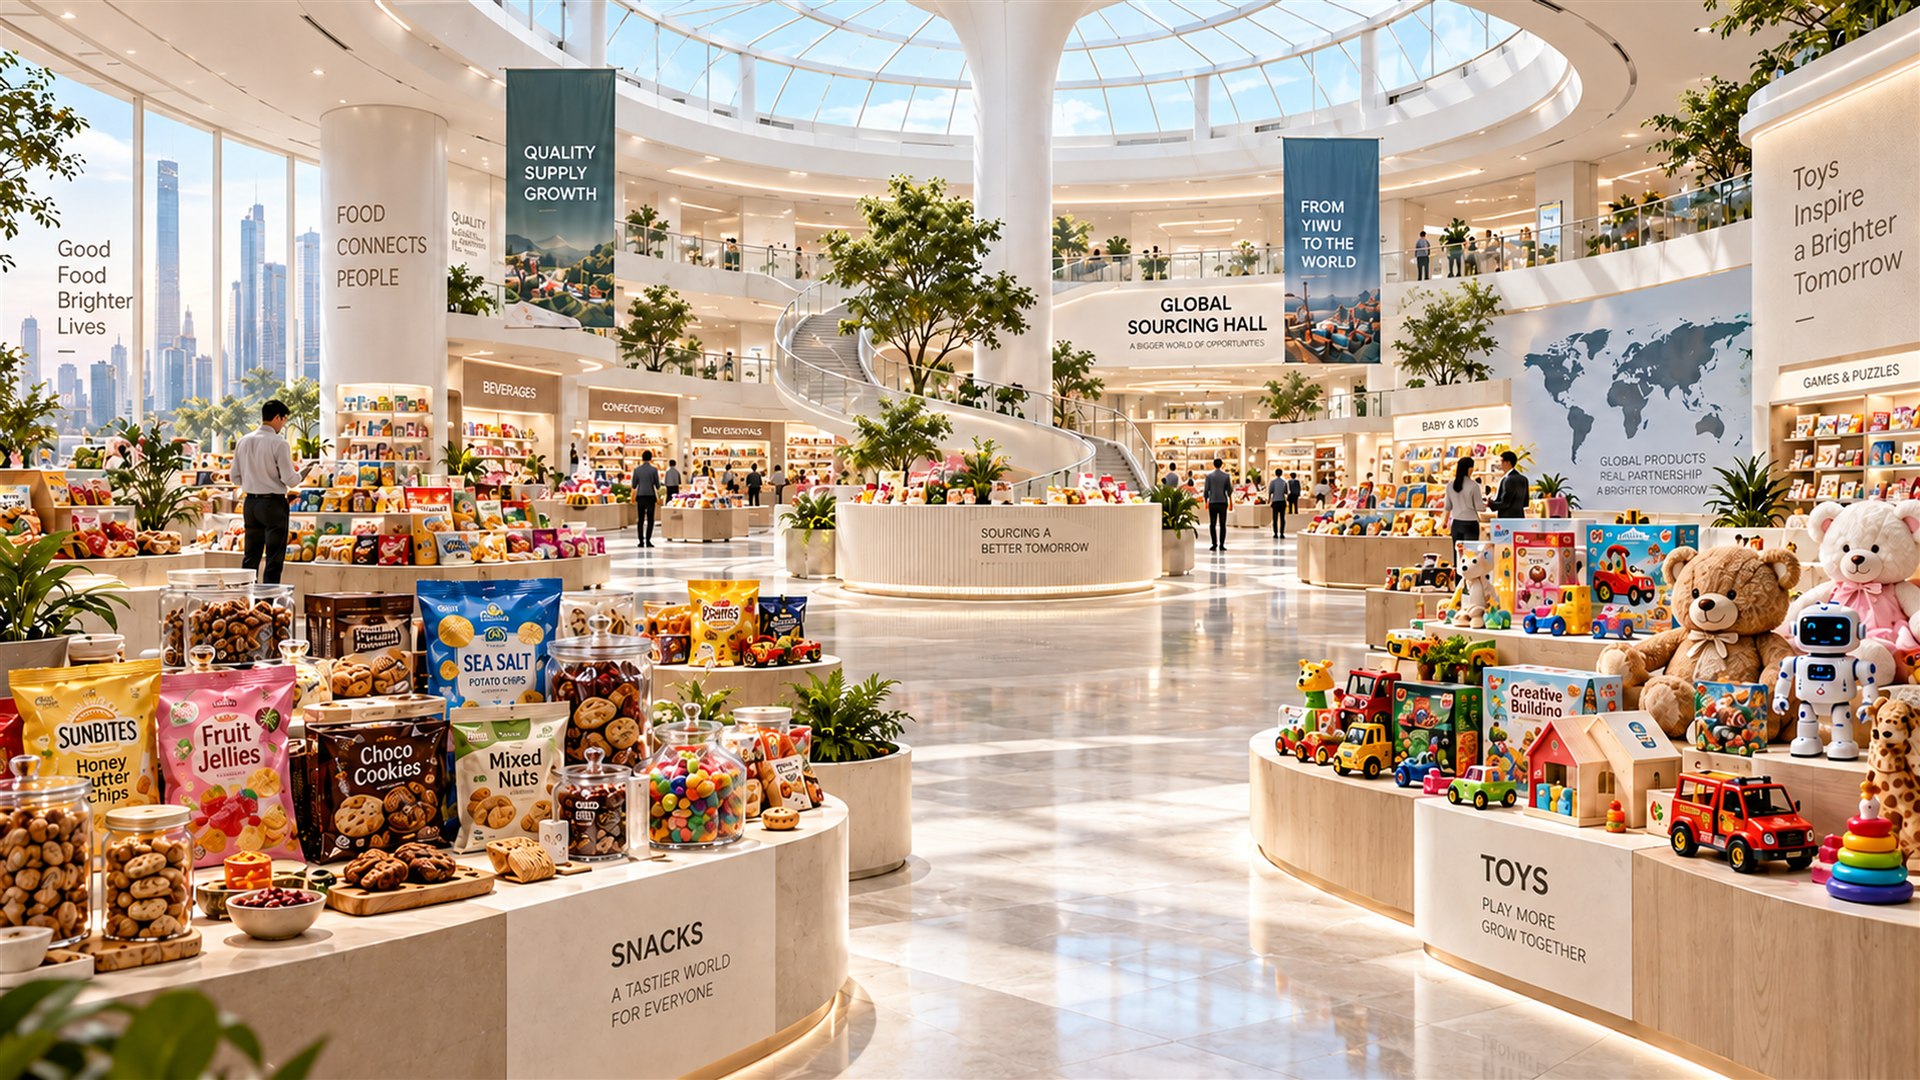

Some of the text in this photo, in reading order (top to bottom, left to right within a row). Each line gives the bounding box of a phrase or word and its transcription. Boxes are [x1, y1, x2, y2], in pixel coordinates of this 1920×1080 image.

[523, 145, 596, 160] QUALITY
[524, 165, 588, 180] SUPPLY
[1793, 160, 1839, 191] Toys
[523, 186, 597, 201] GROWTH
[337, 204, 385, 224] FOOD
[1301, 200, 1345, 214] FROM
[1794, 188, 1865, 227] Inspire
[1301, 219, 1342, 232] YIWU
[337, 235, 428, 256] CONNECTS
[1301, 237, 1354, 250] TO THE
[1794, 214, 1898, 261] a Brighter
[58, 239, 111, 258] Good
[1301, 255, 1357, 269] WORLD
[58, 266, 106, 284] Food
[337, 268, 399, 288] PEOPLE
[1793, 250, 1903, 295] Tomorrow
[58, 291, 134, 313] Brighter
[1160, 295, 1232, 313] GLOBAL
[58, 317, 106, 335] Lives
[1127, 315, 1268, 335] SOURCING HALL
[1129, 342, 1136, 350] A
[1165, 340, 1193, 349] WORLD
[1194, 340, 1205, 349] OF
[1803, 363, 1901, 389] GAMES & PUZZLES
[482, 380, 537, 400] BEVERAGES
[1422, 417, 1479, 432] BABY & KIDS
[1600, 453, 1706, 467] GLOBAL PRODUCTS
[1600, 468, 1703, 481] REAL PARTNERSHIP
[1596, 486, 1604, 496] A
[1649, 485, 1708, 496] TOMORROW
[981, 527, 1052, 539] SOURCING A
[981, 542, 1089, 554] BETTER TOMORROW
[464, 652, 531, 673] SEA SALT
[469, 676, 501, 687] POTATO
[1511, 683, 1563, 704] Creative
[58, 720, 137, 749] SUNBITES
[202, 722, 252, 747] Fruit
[198, 746, 261, 773] Jellies
[360, 744, 413, 765] Choco
[489, 748, 542, 770] Mixed
[76, 756, 127, 774] Honey
[354, 760, 421, 787] Cookies
[78, 772, 130, 788] utter
[499, 769, 539, 788] Nuts
[1480, 854, 1548, 895] TOYS
[1482, 897, 1556, 931] PLAY MORE
[611, 921, 703, 968] SNACKS
[1481, 919, 1586, 964] GROW TOGETHER
[611, 953, 731, 1003] A TASTIER WORLD
[611, 981, 714, 1028] FOR EVERYONE
